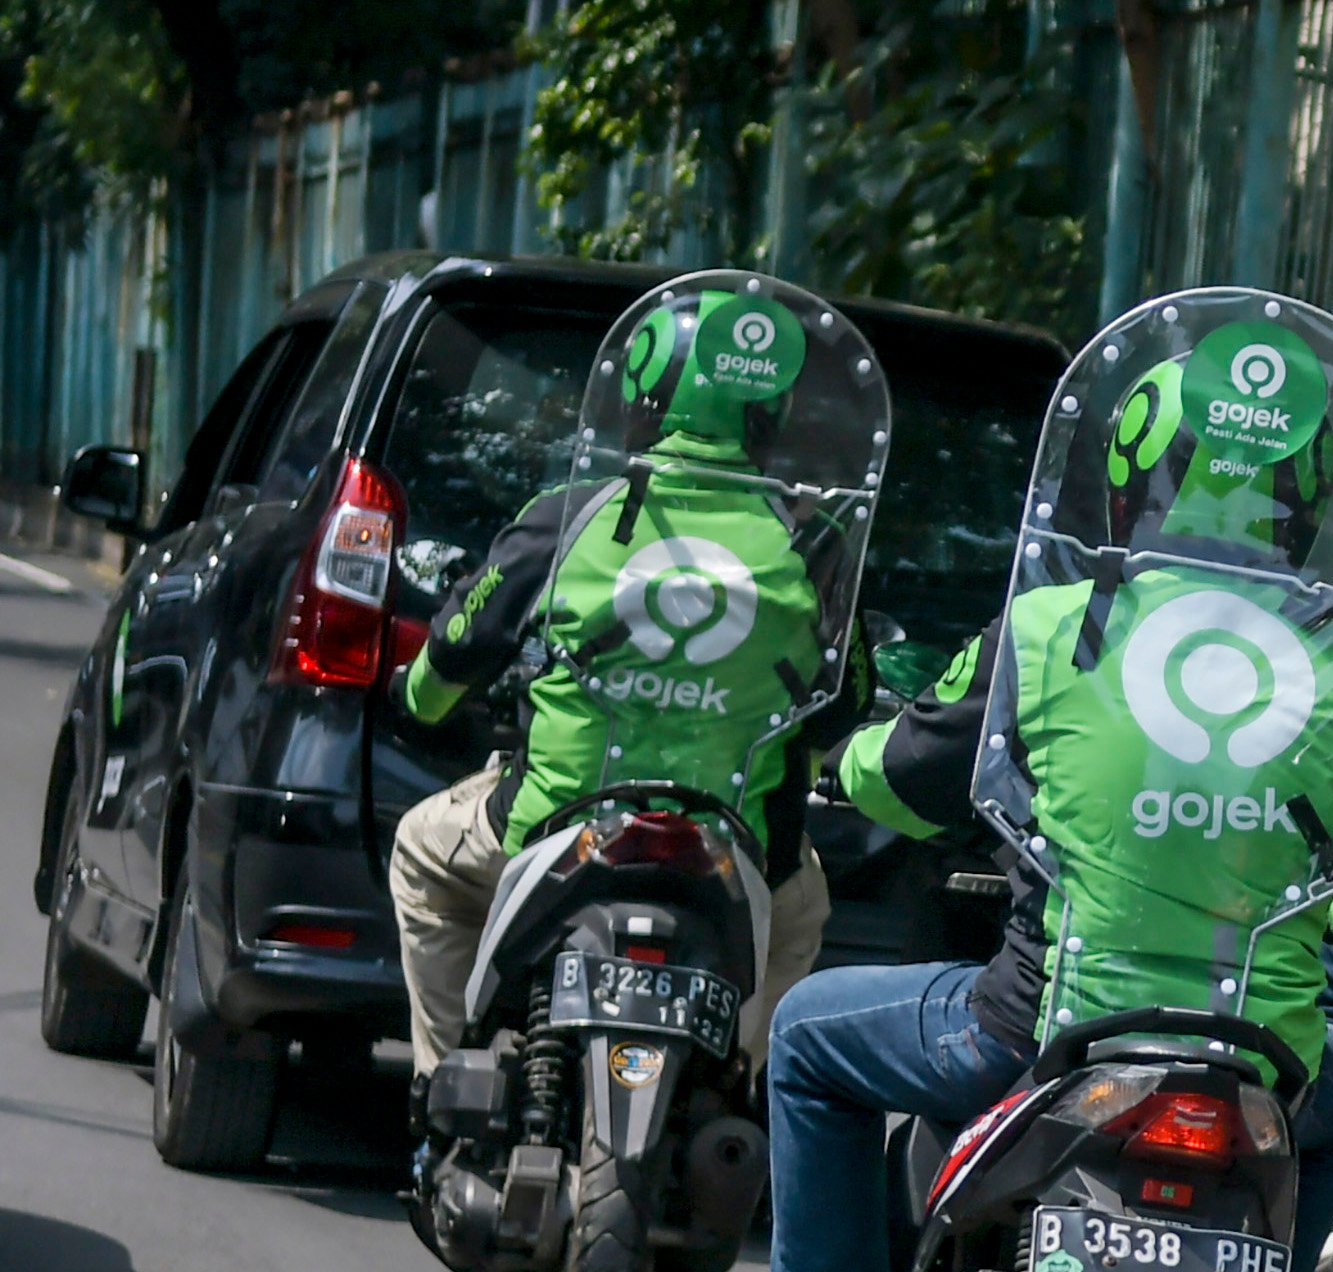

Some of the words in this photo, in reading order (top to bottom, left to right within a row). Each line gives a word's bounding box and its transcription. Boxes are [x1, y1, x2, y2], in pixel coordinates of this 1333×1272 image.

[716, 353, 778, 376] gojek
[1208, 400, 1291, 432] gojek
[1205, 425, 1233, 438] Pasti
[1235, 432, 1256, 443] Ada
[1258, 437, 1287, 450] Jalan
[1209, 459, 1259, 477] gojek
[604, 665, 731, 714] gojek
[1132, 787, 1298, 840] gojek
[562, 958, 579, 988] B
[600, 962, 672, 998] 3226
[688, 975, 733, 1019] PES
[1040, 1215, 1062, 1253] B
[1084, 1218, 1181, 1267] 3538
